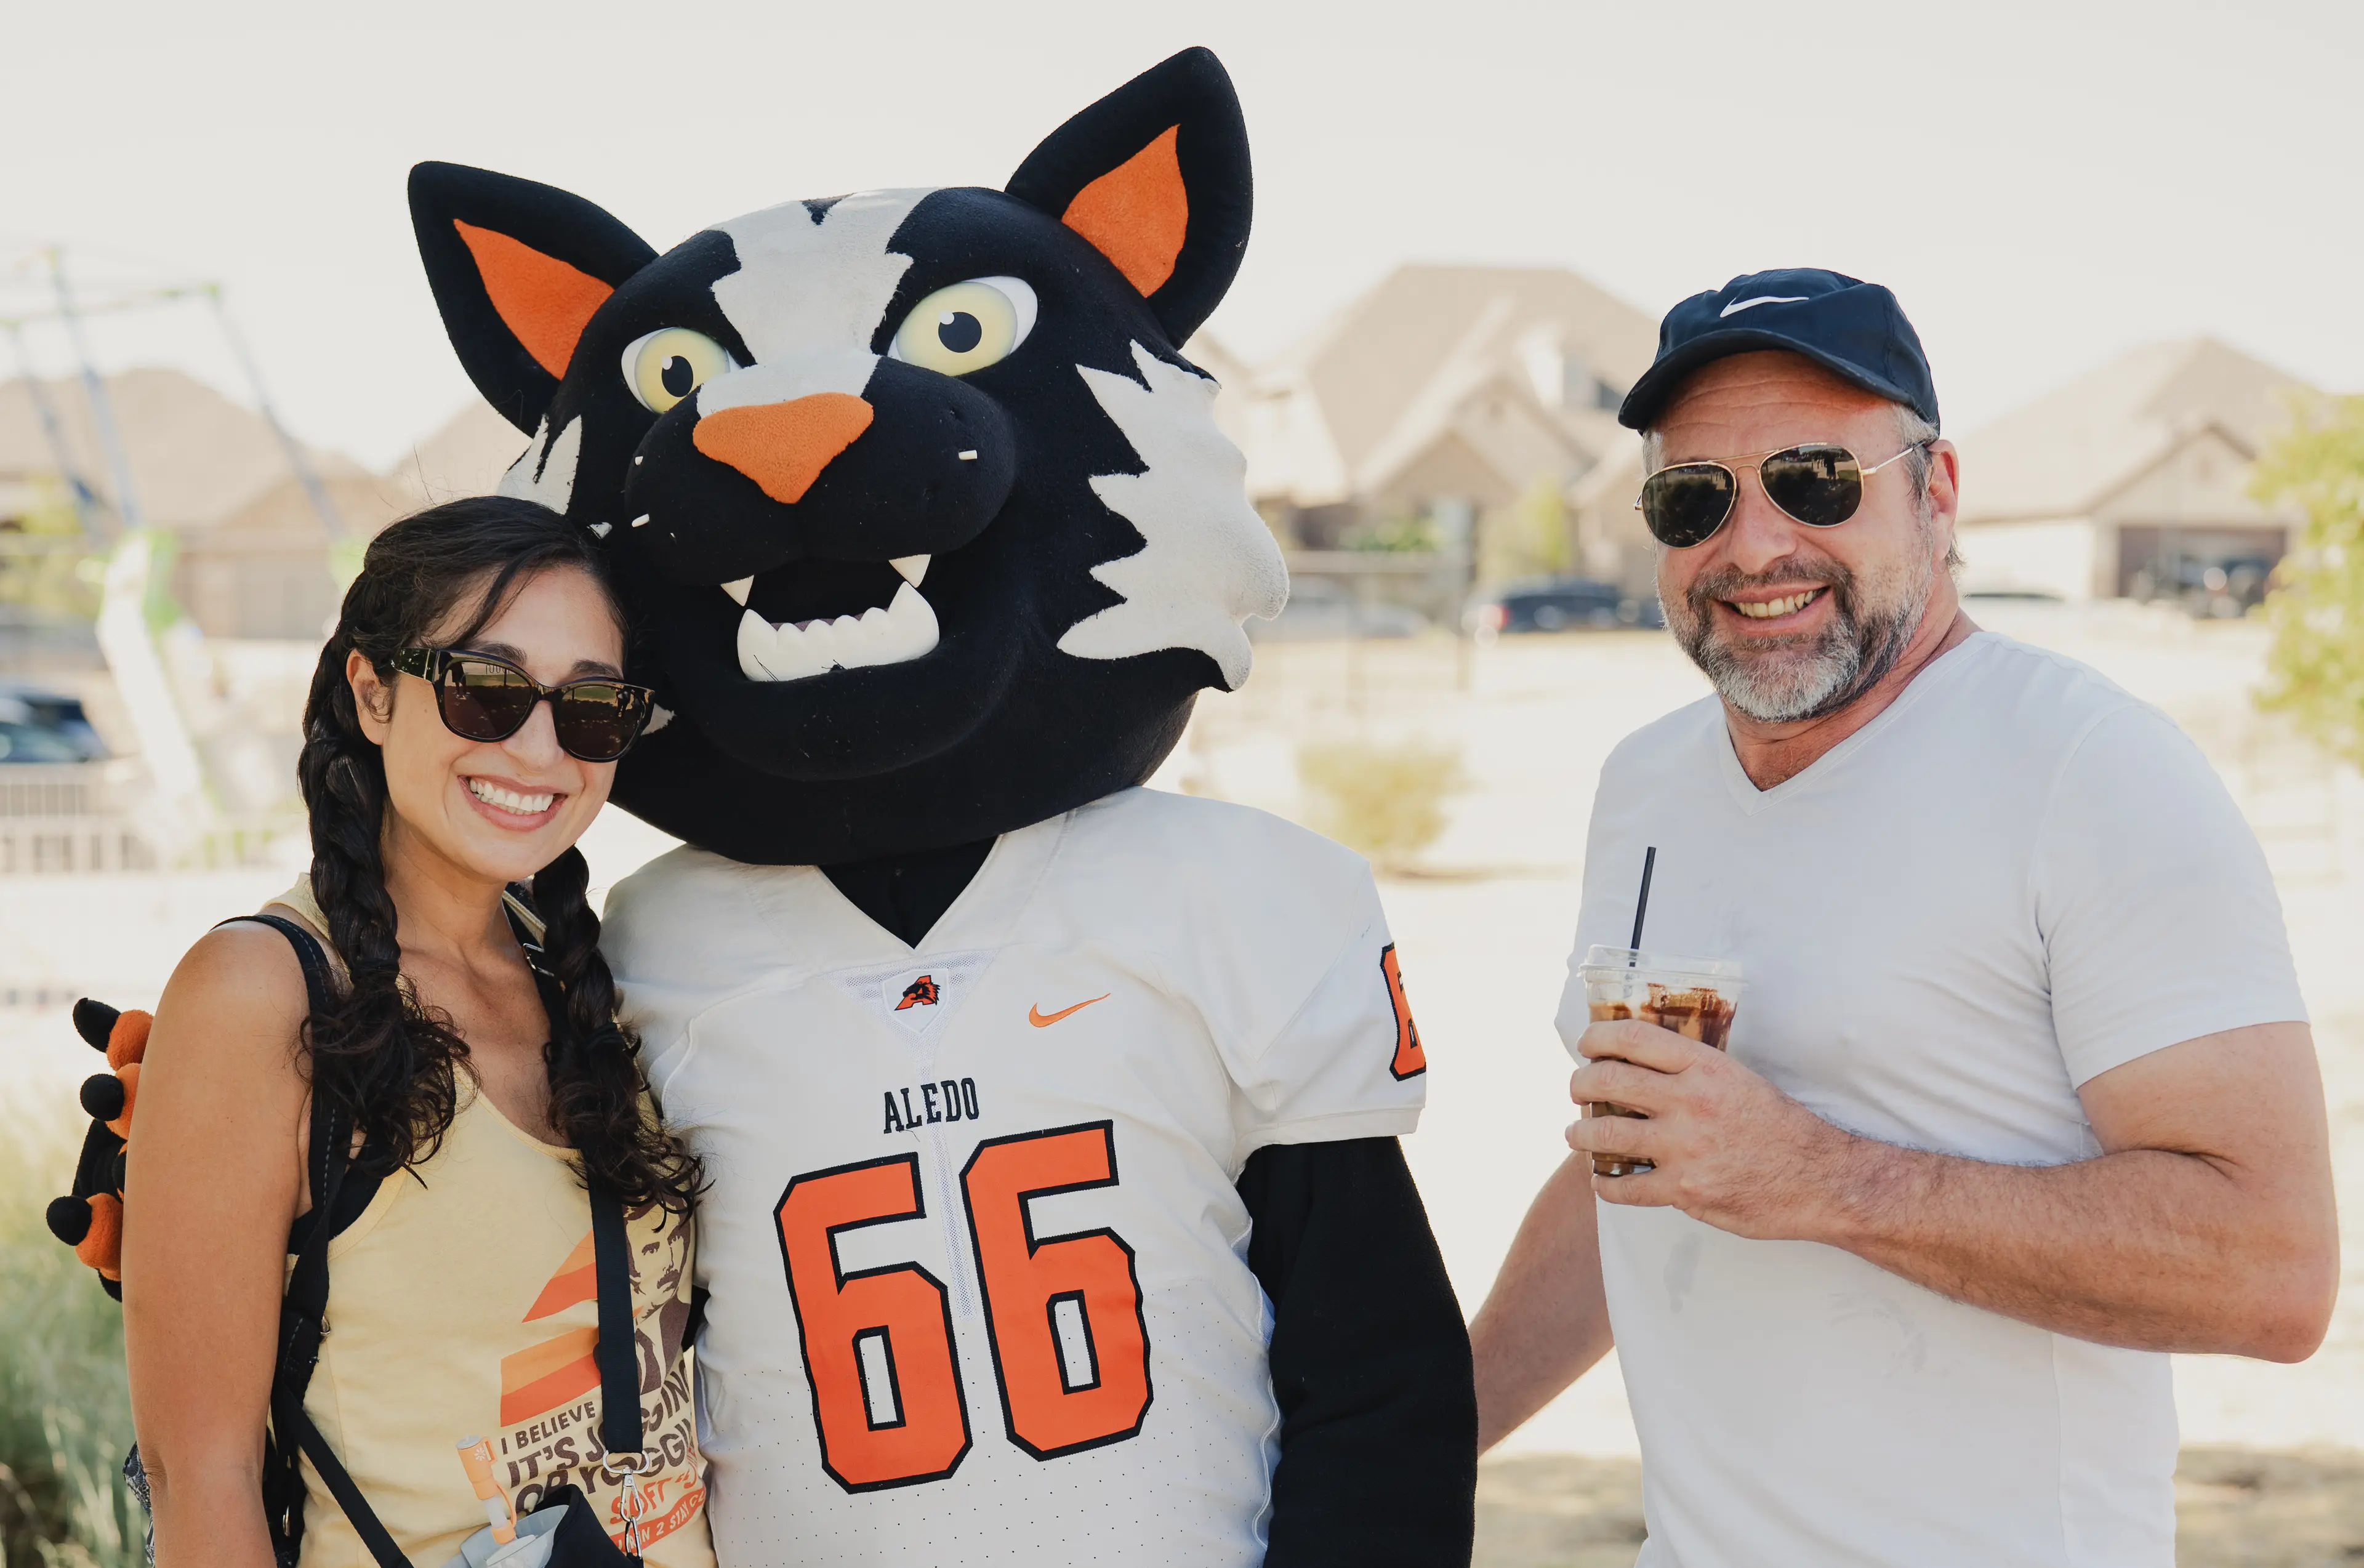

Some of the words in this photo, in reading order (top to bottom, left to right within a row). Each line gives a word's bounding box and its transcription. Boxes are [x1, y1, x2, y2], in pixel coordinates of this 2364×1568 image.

[884, 1077, 979, 1134] ALEDO
[774, 1119, 1153, 1494] 66
[501, 1437, 508, 1455] I
[515, 1401, 595, 1449] BELIEVE
[507, 1436, 579, 1489] IT'S
[610, 1478, 673, 1524] SOFT
[656, 1522, 664, 1535] 2
[670, 1500, 690, 1529] STAY
